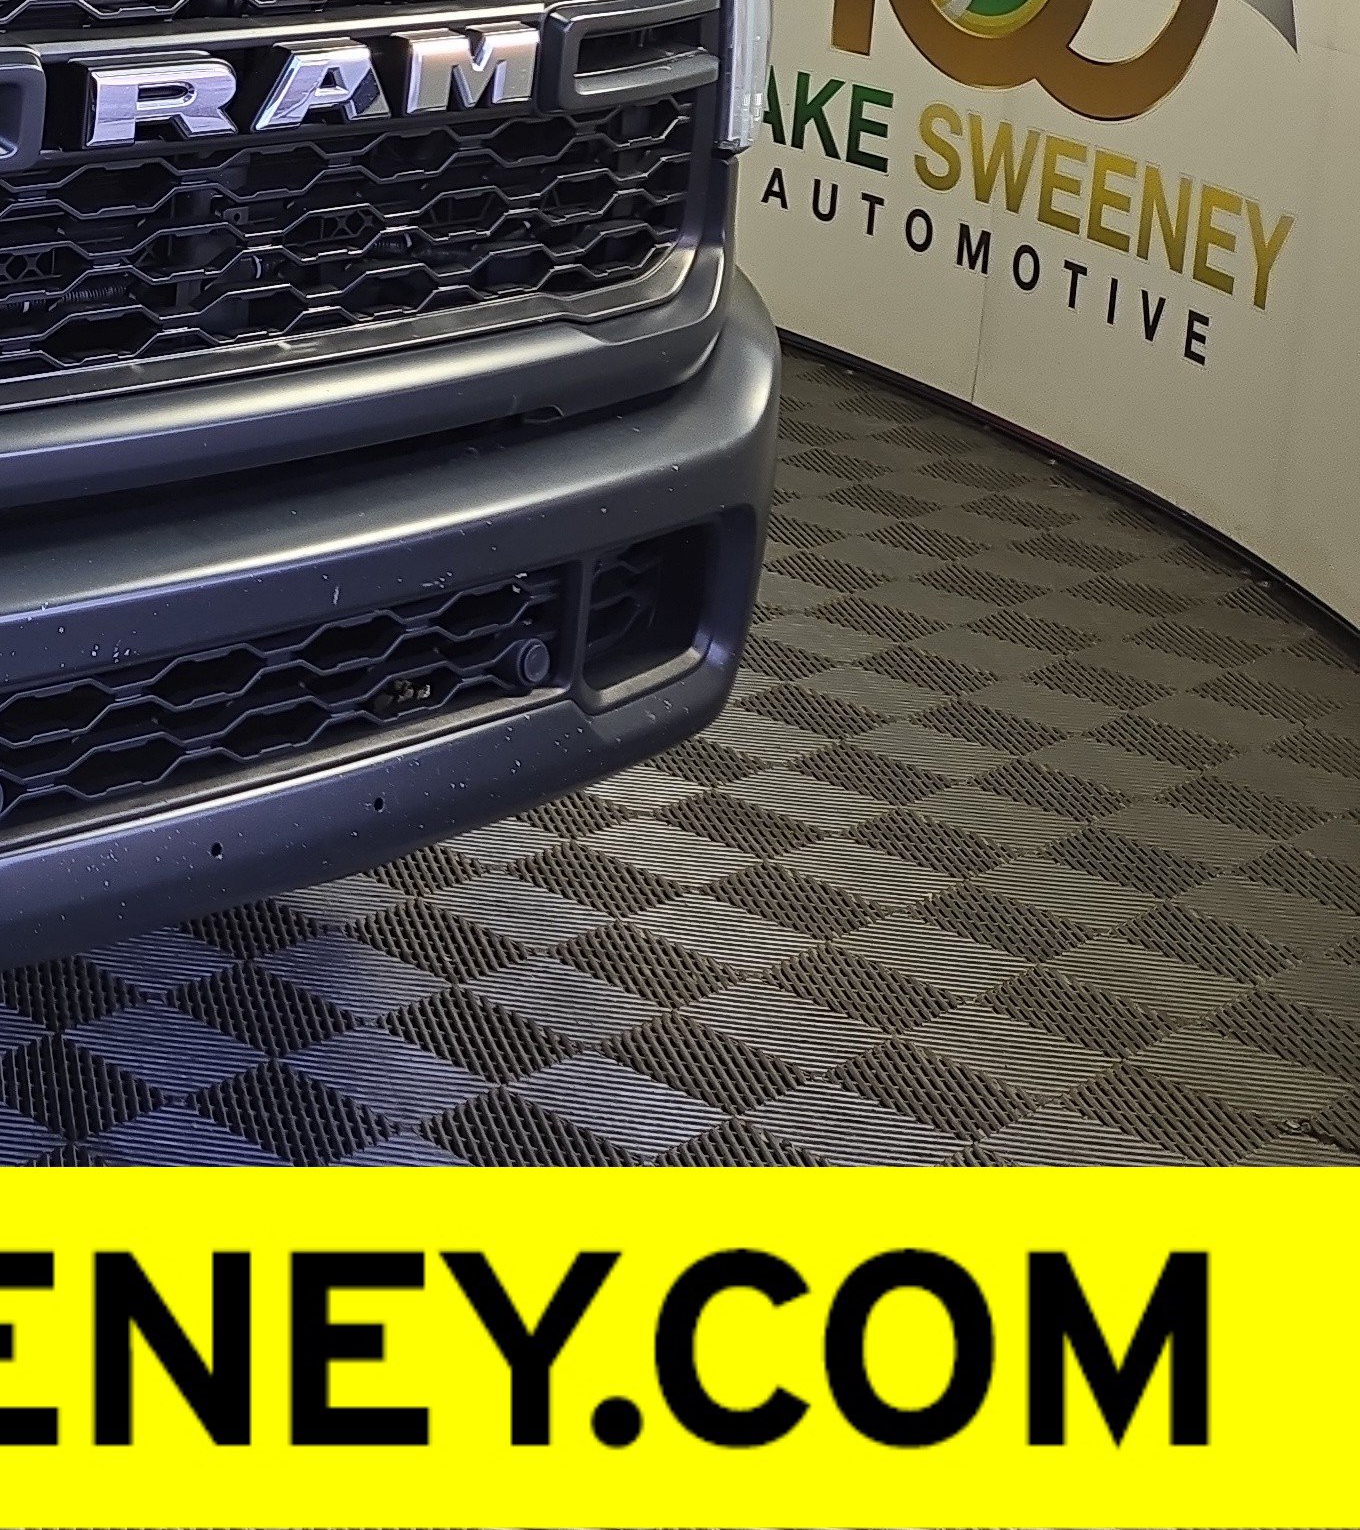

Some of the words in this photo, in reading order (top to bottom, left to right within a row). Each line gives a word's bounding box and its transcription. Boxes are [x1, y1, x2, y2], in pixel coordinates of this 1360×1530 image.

[78, 21, 541, 149] RAM
[760, 167, 1211, 366] AUTOMOTIVE
[762, 64, 895, 175] AKE
[914, 103, 1296, 312] SWEENEY
